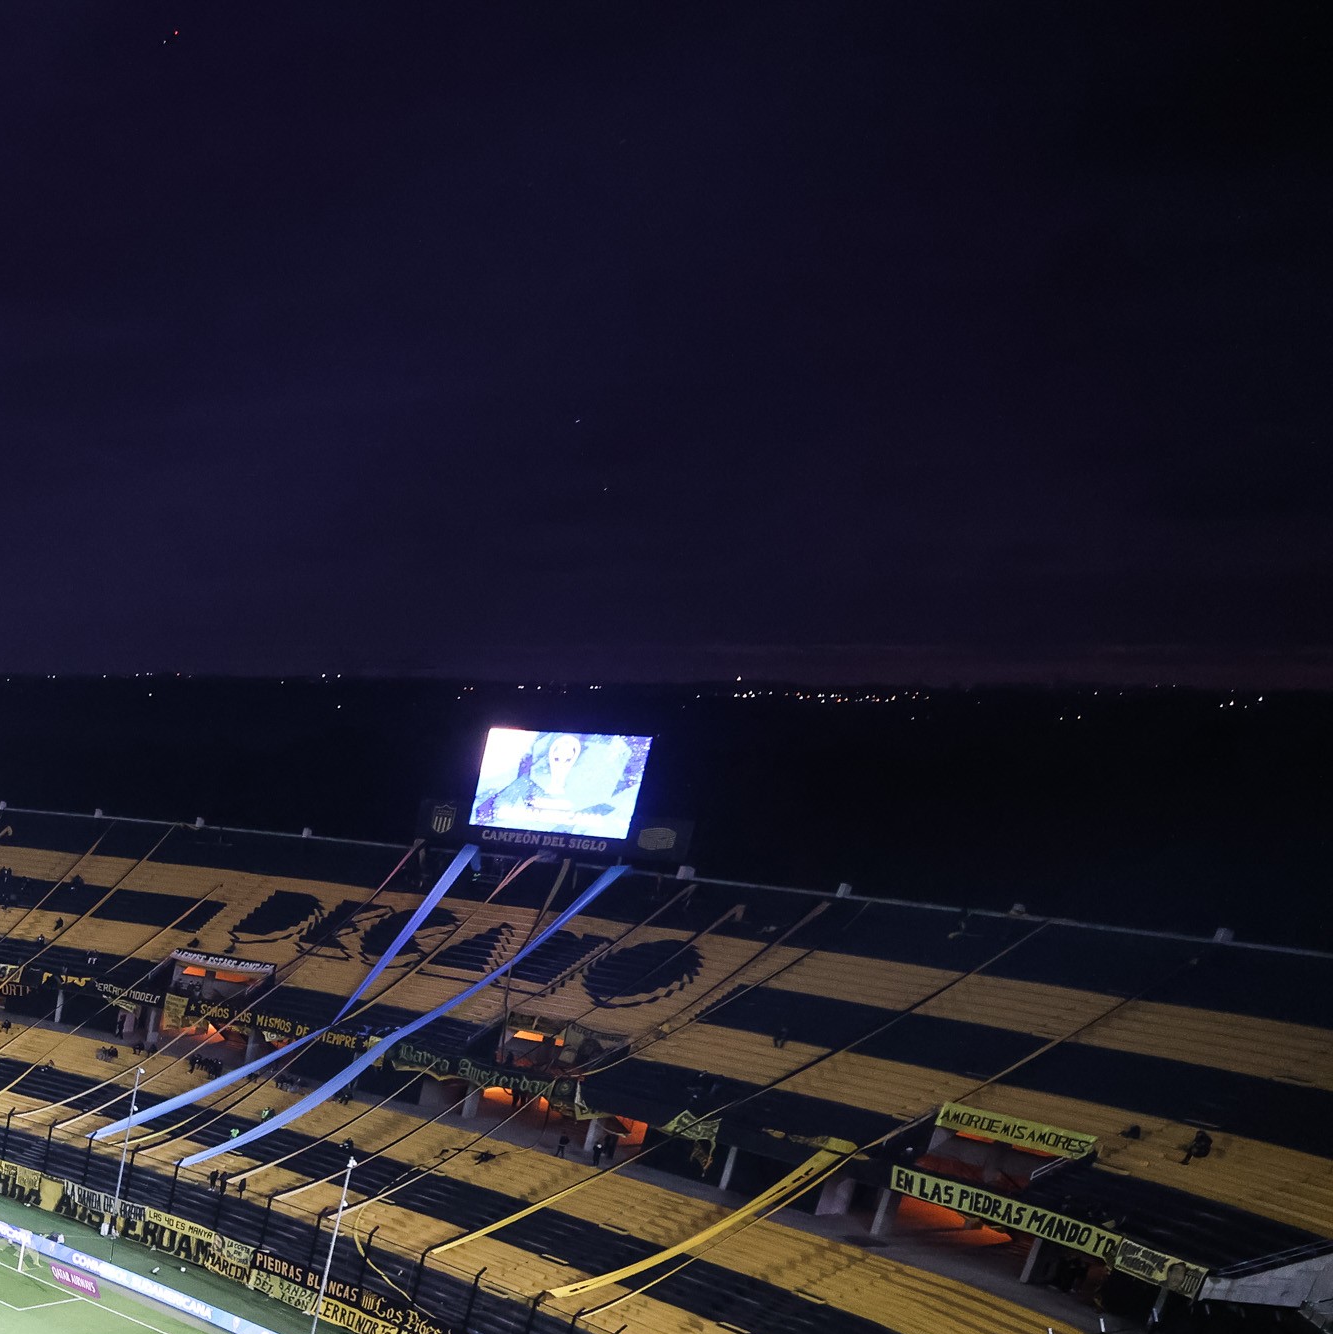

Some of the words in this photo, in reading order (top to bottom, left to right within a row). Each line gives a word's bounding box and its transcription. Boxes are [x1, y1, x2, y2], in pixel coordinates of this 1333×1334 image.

[482, 829, 541, 846] CAMPEÓN
[541, 836, 566, 848] DEL
[568, 839, 608, 852] SIGLO
[200, 1003, 230, 1018] SOMOS
[256, 1014, 292, 1033] MISMOS
[295, 1024, 310, 1037] DE
[941, 1108, 981, 1129] AMOR
[980, 1116, 999, 1135] DE
[1000, 1121, 1025, 1141] MIS
[1024, 1129, 1091, 1153] AMORES
[896, 1169, 914, 1191] EN
[919, 1177, 954, 1205] LAS
[958, 1188, 1023, 1226] PIEDRAS
[1028, 1209, 1091, 1248] MANDO
[148, 1210, 163, 1223] LAS
[164, 1218, 174, 1228] 40
[175, 1219, 186, 1231] ES
[187, 1223, 214, 1240] MANYA
[51, 1265, 72, 1284] QATAR
[71, 1274, 96, 1294] AIRWAYS
[72, 1252, 132, 1286] CONMEBOL
[132, 1276, 214, 1320] SUDAMERICANA
[256, 1252, 303, 1283] PIEDRAS
[306, 1271, 358, 1303] BLANCAS
[315, 1298, 356, 1327] CERRO
[373, 1297, 404, 1325] Los
